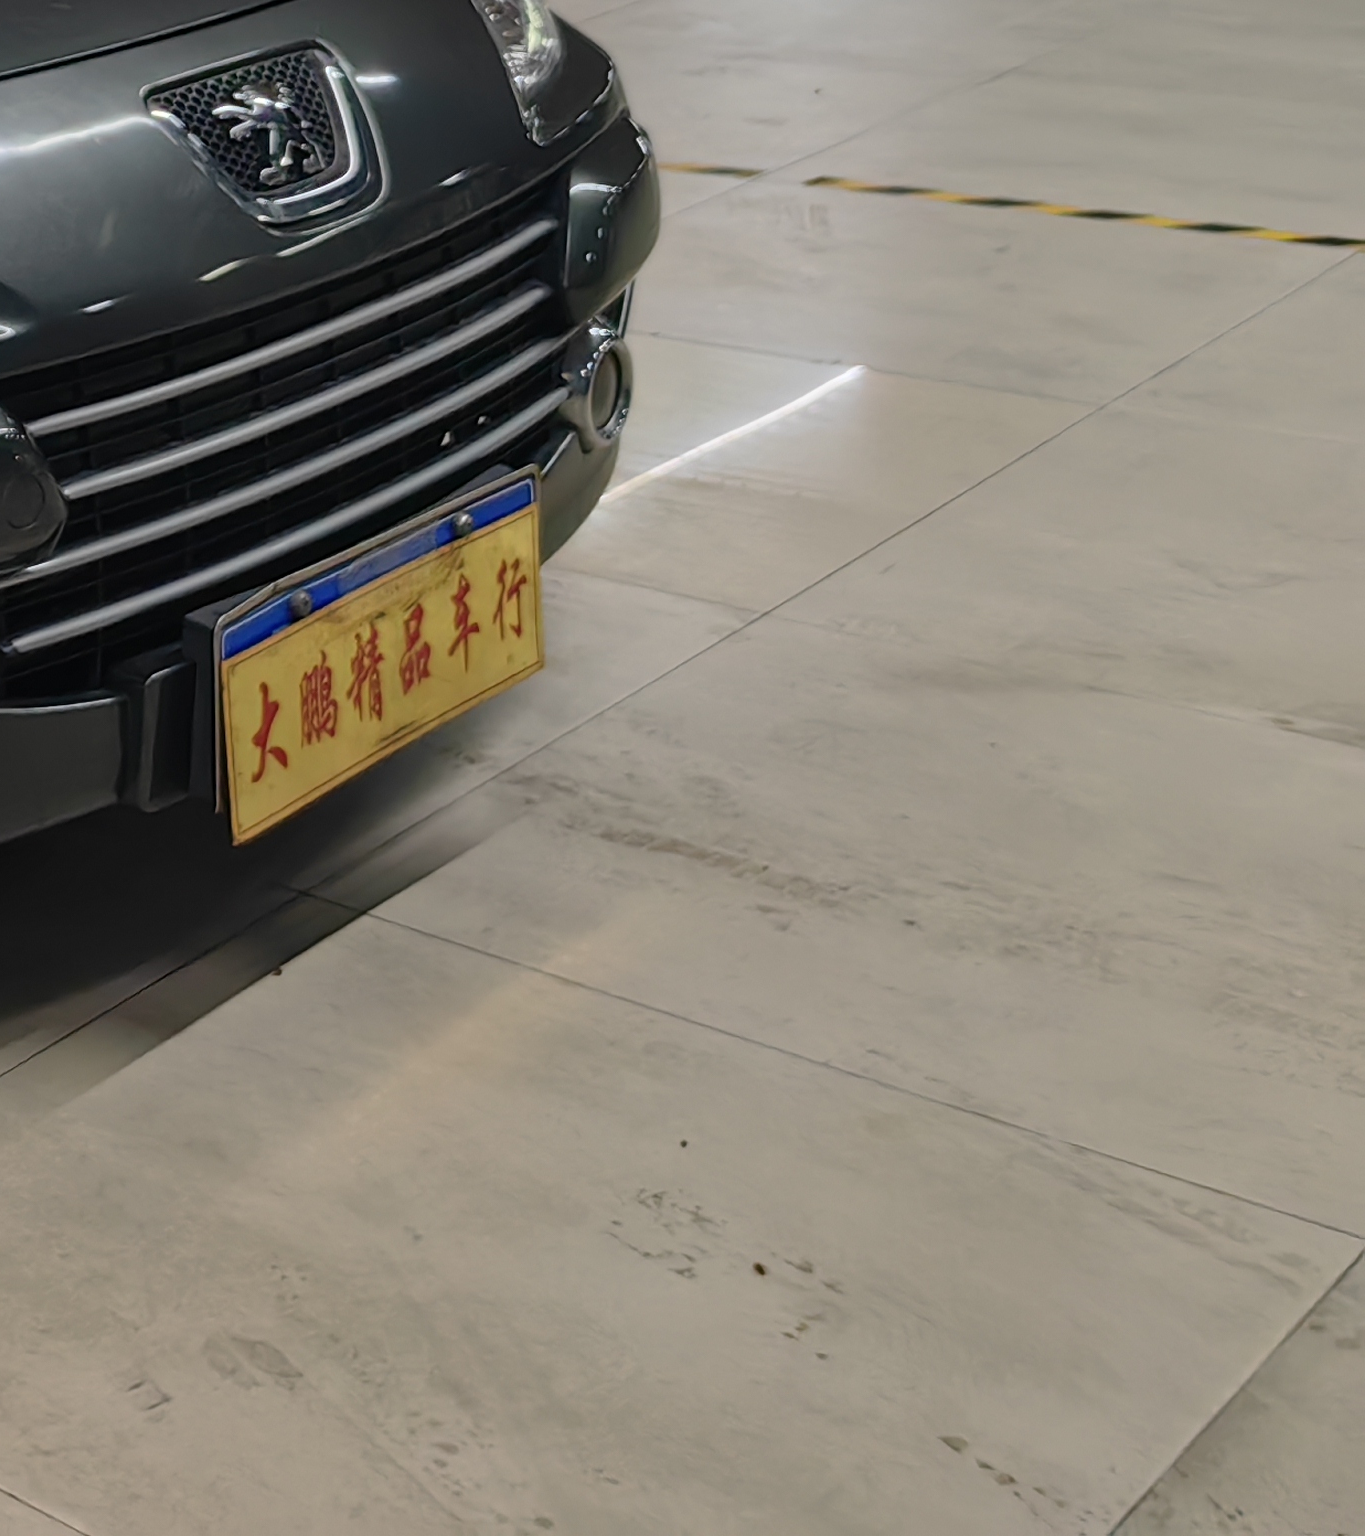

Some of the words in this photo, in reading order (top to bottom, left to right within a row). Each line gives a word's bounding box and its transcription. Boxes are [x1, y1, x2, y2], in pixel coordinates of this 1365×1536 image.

[249, 557, 527, 783] 大鹏精品车行
